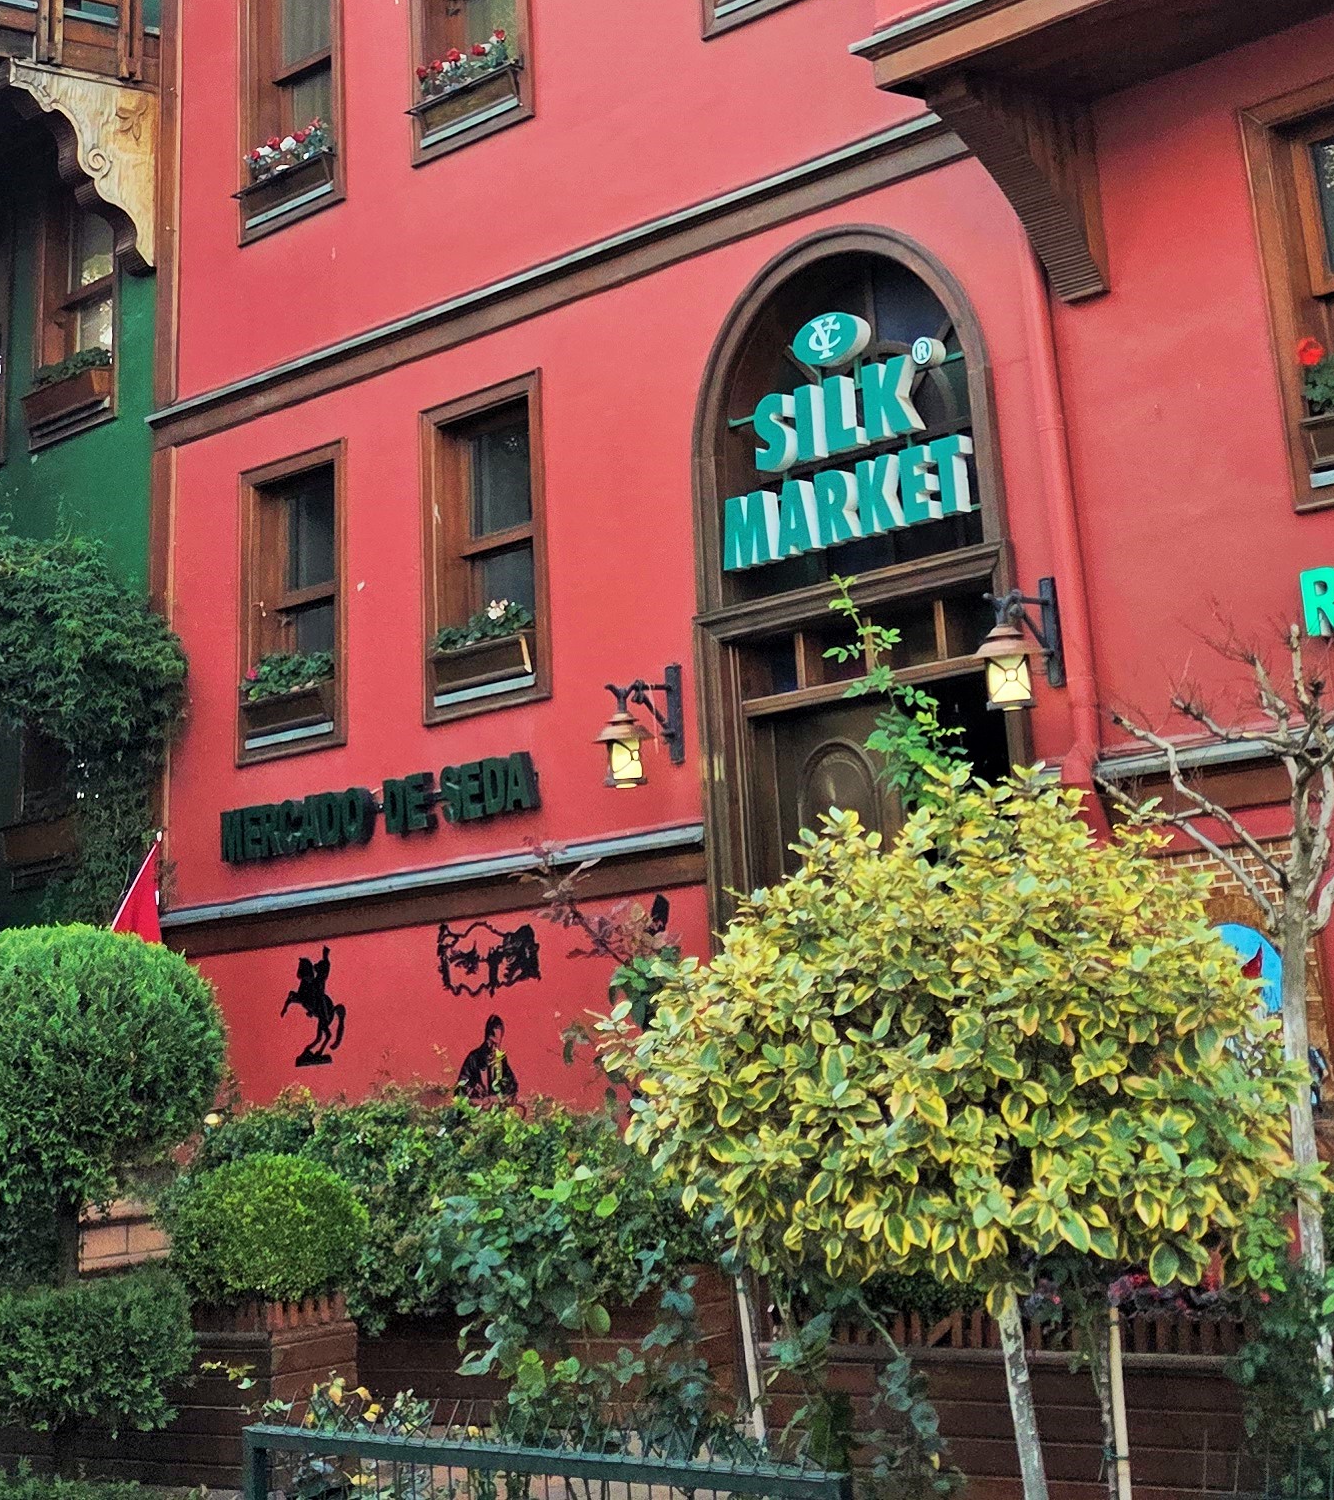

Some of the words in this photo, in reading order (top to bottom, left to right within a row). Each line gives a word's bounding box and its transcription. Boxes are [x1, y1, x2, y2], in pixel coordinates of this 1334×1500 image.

[753, 355, 926, 472] SILK
[723, 434, 973, 572] MARKET
[220, 786, 375, 863] MERCADO
[383, 772, 437, 835] DE
[440, 751, 540, 823] SEDA
